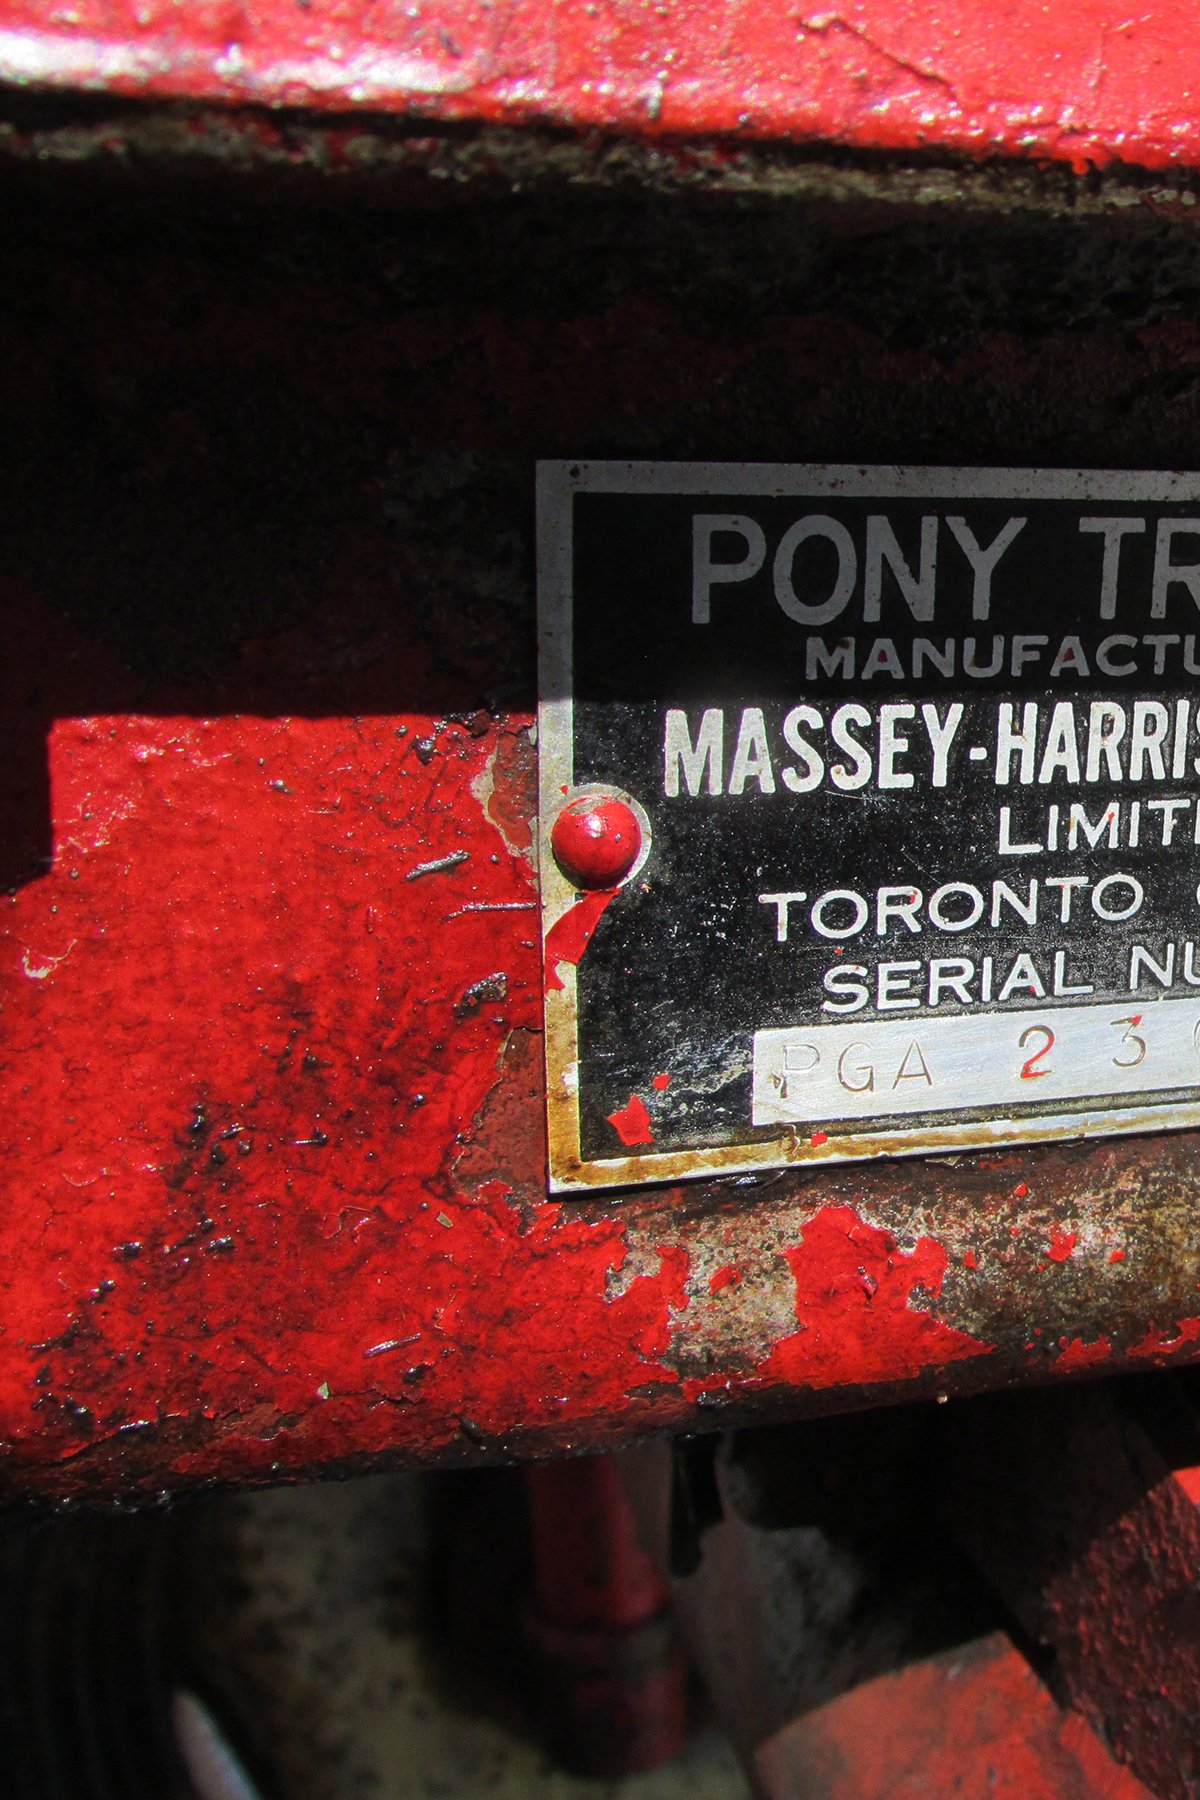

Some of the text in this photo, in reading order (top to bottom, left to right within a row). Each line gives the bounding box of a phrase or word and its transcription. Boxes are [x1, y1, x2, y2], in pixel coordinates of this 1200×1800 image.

[691, 513, 1028, 625] PONY
[757, 873, 1143, 942] TORONTO
[821, 953, 1094, 1014] SERIAL
[780, 1039, 934, 1099] PGA
